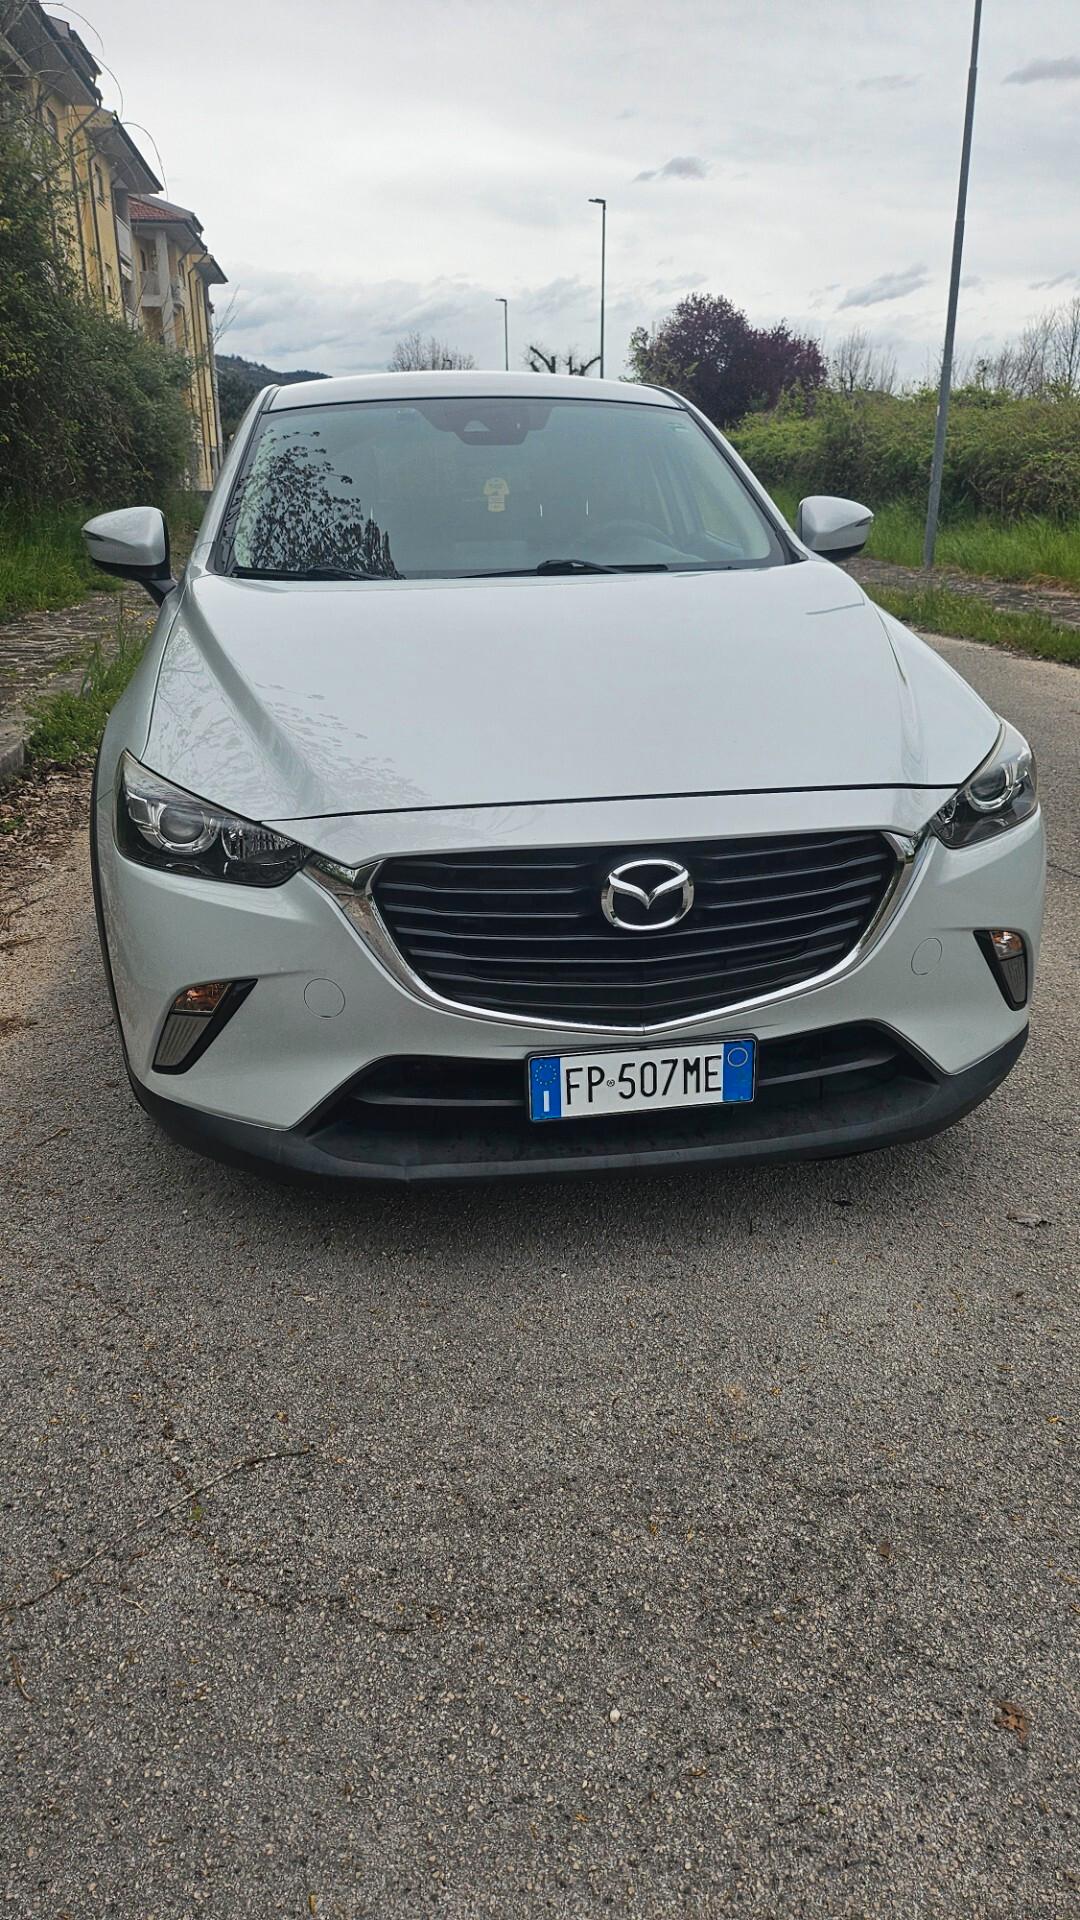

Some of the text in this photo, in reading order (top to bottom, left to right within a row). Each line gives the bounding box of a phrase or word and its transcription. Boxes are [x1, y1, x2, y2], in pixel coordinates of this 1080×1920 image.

[566, 1055, 722, 1105] FP 507ME
[543, 1090, 550, 1112] I
